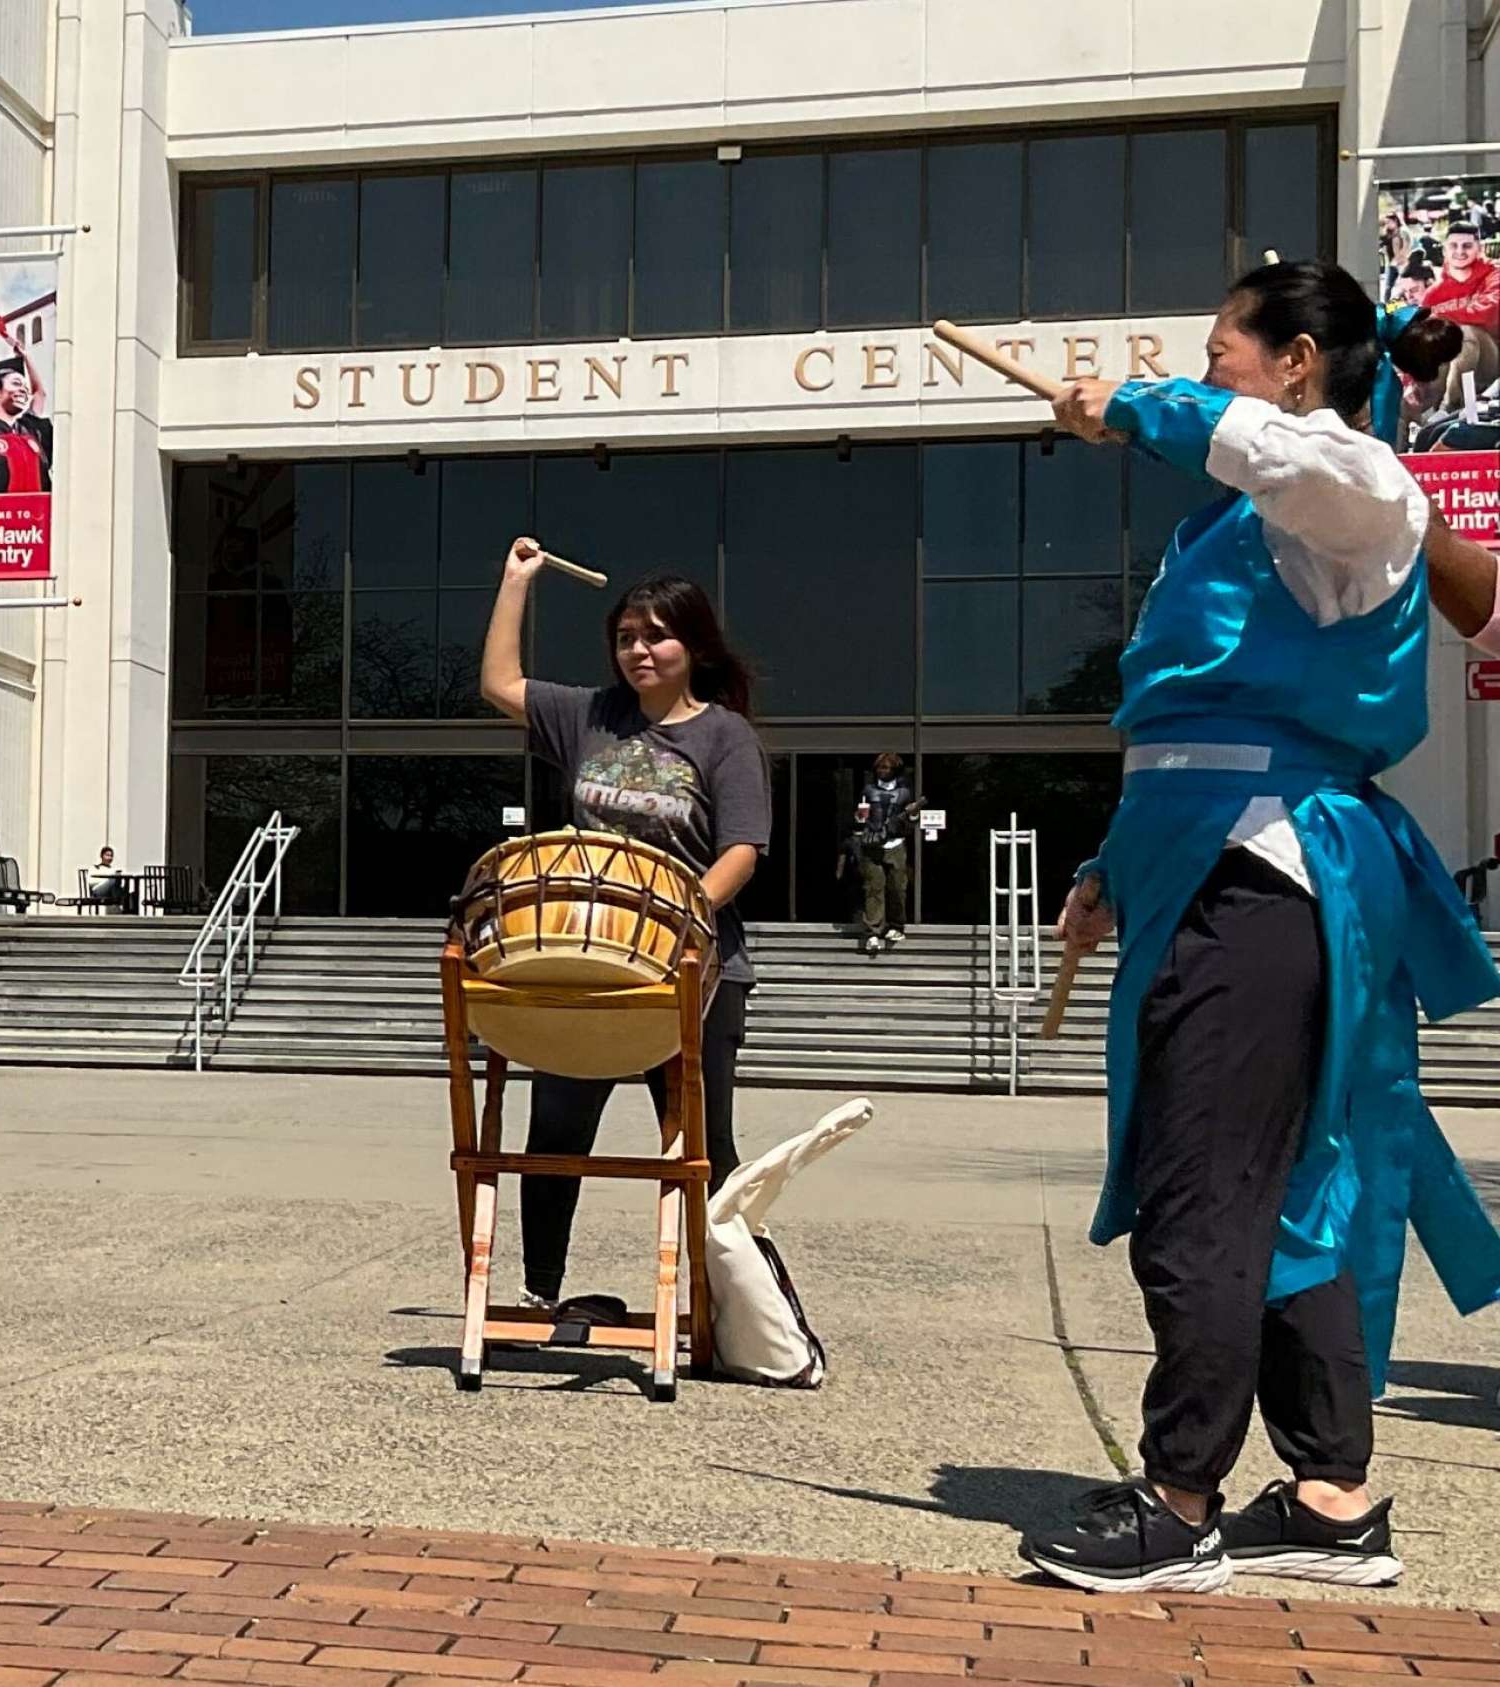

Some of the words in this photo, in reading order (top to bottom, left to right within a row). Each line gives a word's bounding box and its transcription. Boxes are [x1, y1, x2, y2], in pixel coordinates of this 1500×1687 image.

[293, 352, 690, 409] STUDENT
[794, 334, 1171, 392] CENTER
[1486, 469, 1500, 479] TO
[1451, 487, 1500, 509] Haw
[17, 510, 31, 519] TO
